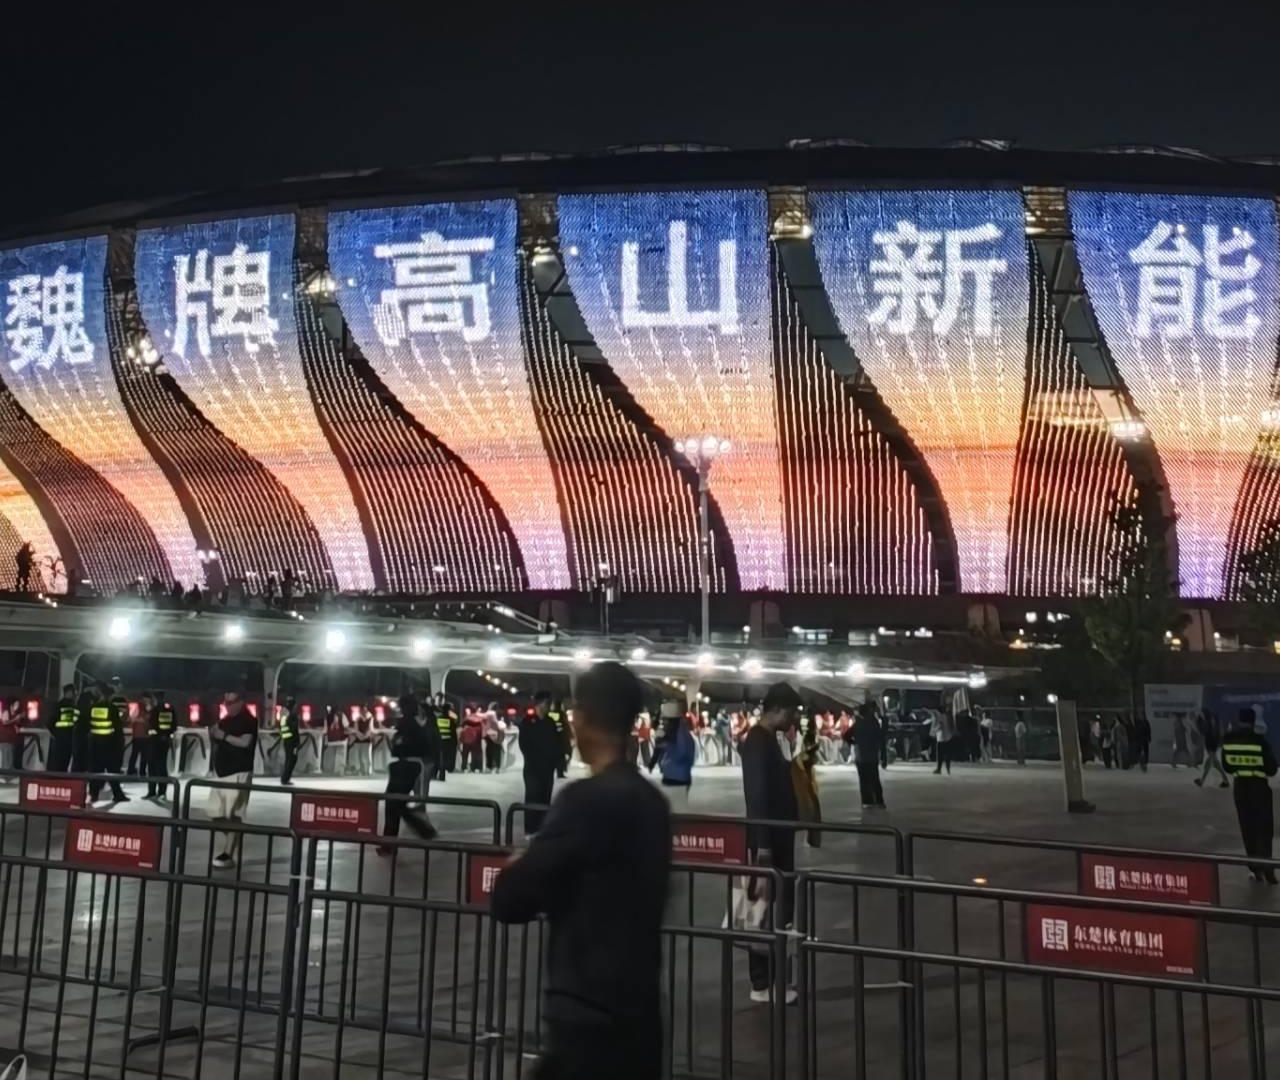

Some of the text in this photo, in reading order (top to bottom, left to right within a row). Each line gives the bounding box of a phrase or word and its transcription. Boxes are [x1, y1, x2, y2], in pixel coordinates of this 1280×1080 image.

[1073, 924, 1163, 951] 东楚体育集团
